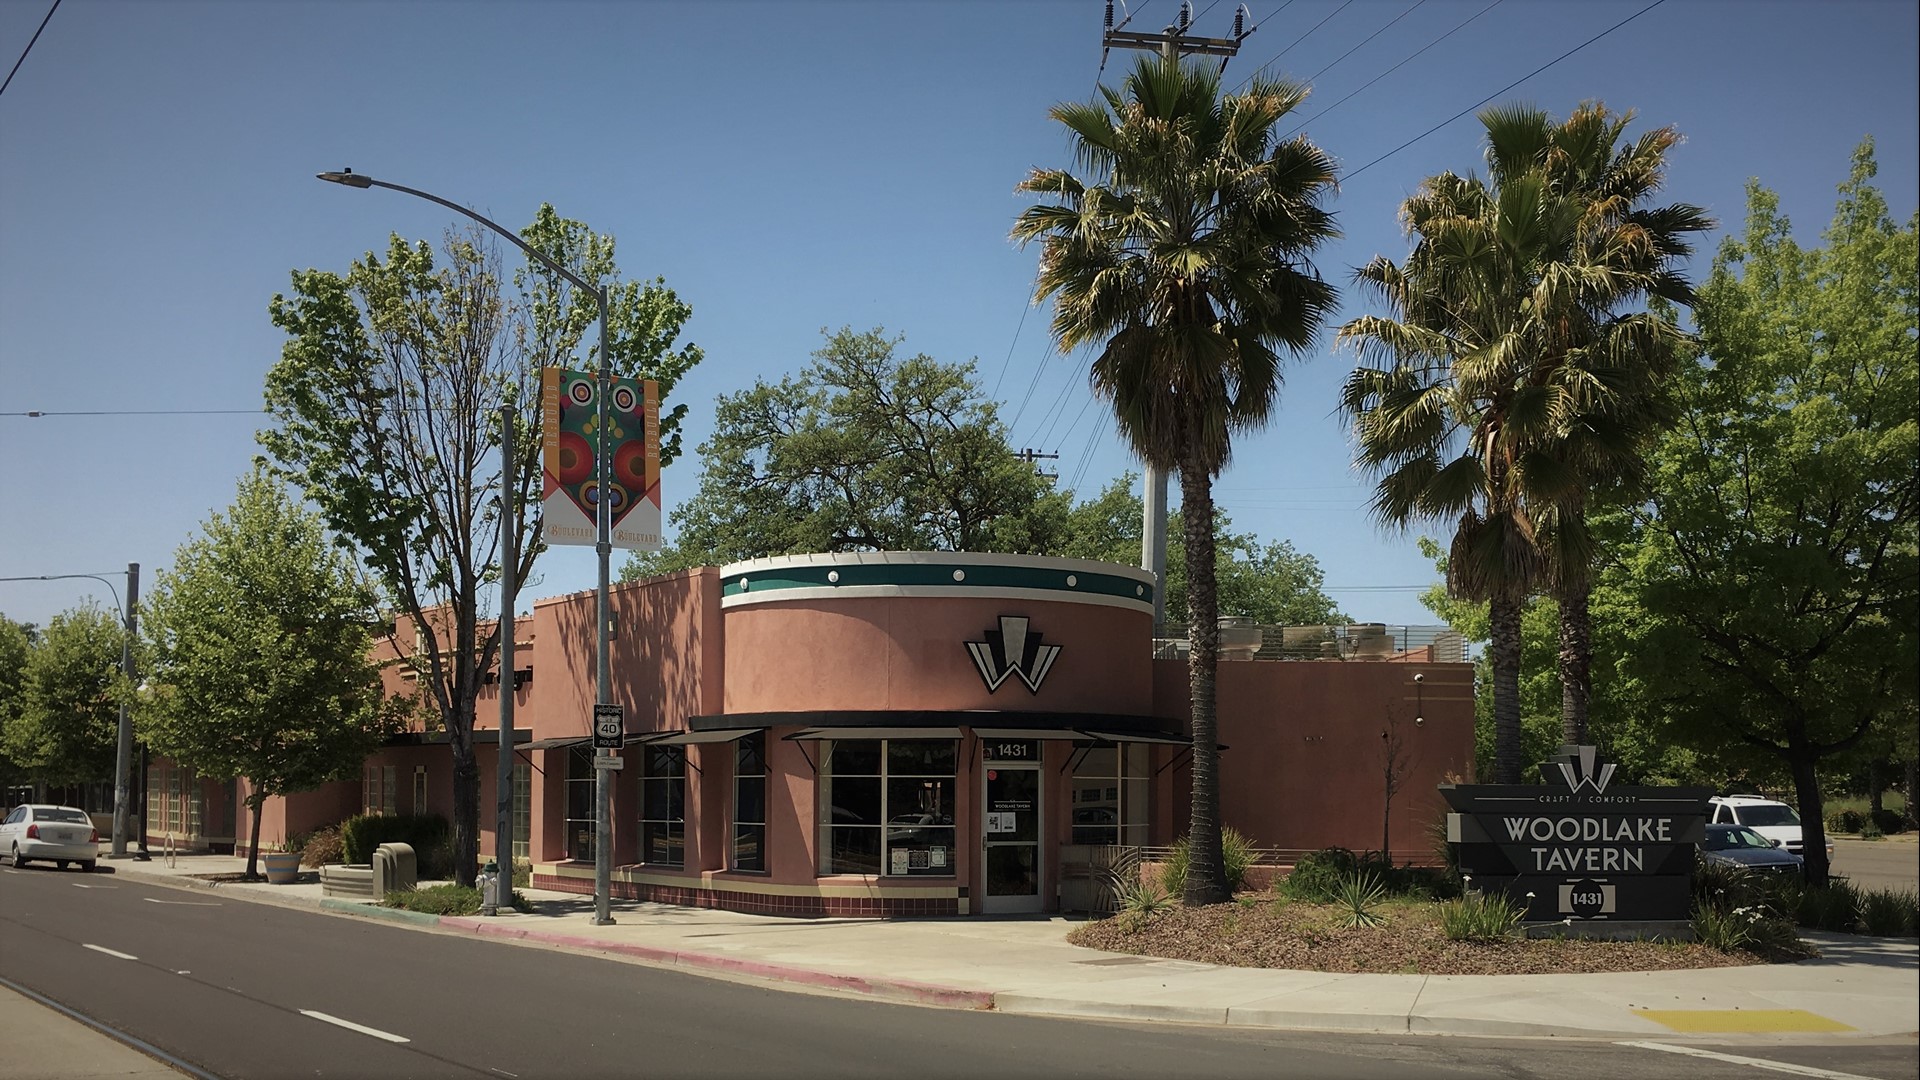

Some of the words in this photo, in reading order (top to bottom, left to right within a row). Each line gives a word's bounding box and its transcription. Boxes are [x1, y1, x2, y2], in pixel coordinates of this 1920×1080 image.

[601, 724, 617, 734] 40
[599, 739, 619, 747] ROUTE
[998, 743, 1027, 757] 1431
[1539, 795, 1570, 803] CRAFT
[1588, 795, 1636, 804] COMFORT
[1503, 817, 1672, 842] WOODLAKE
[1531, 847, 1643, 872] TAVERN
[1572, 892, 1602, 905] 1431
